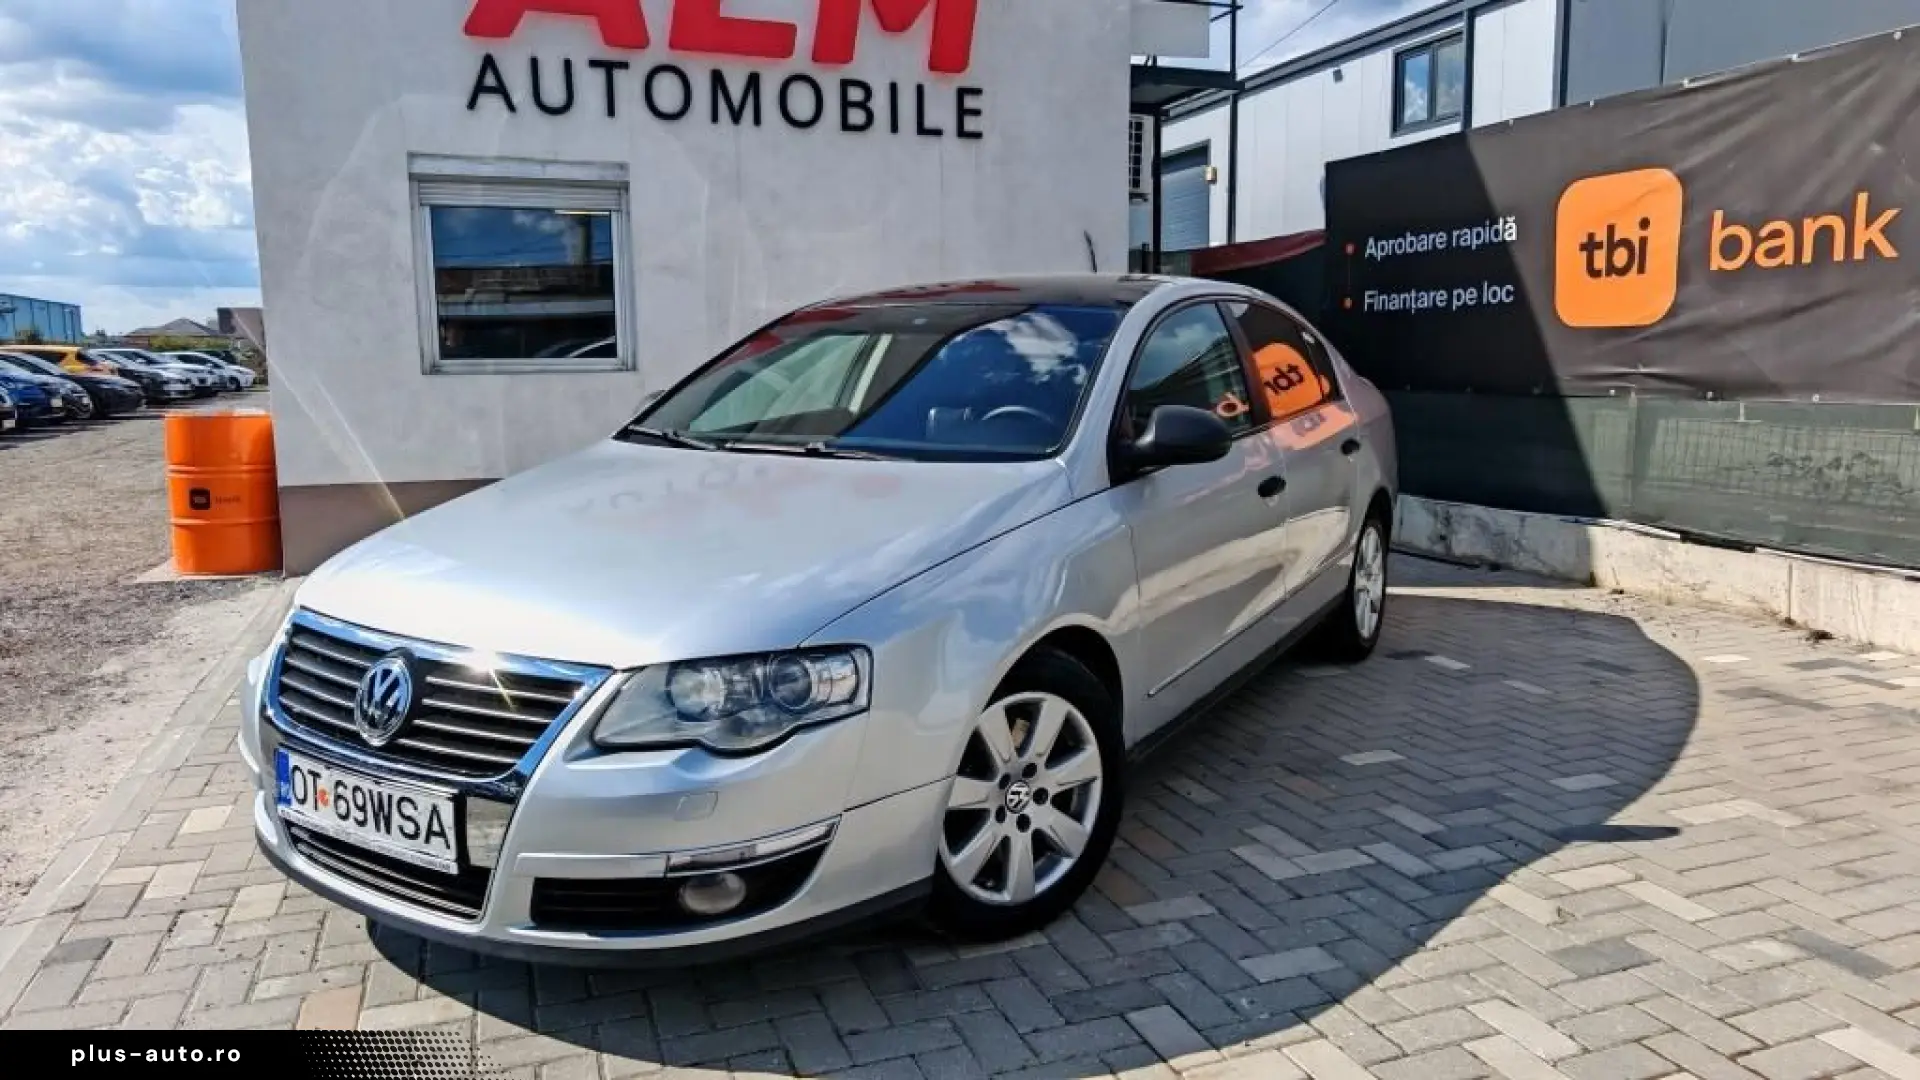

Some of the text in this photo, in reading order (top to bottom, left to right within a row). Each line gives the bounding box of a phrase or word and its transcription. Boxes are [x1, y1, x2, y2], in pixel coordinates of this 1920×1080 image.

[467, 53, 983, 139] AUTOMOBILE
[1365, 216, 1518, 261] Aprobare rapidă
[1579, 192, 1902, 279] tbi bank
[1364, 280, 1515, 314] Finanțare pe loc
